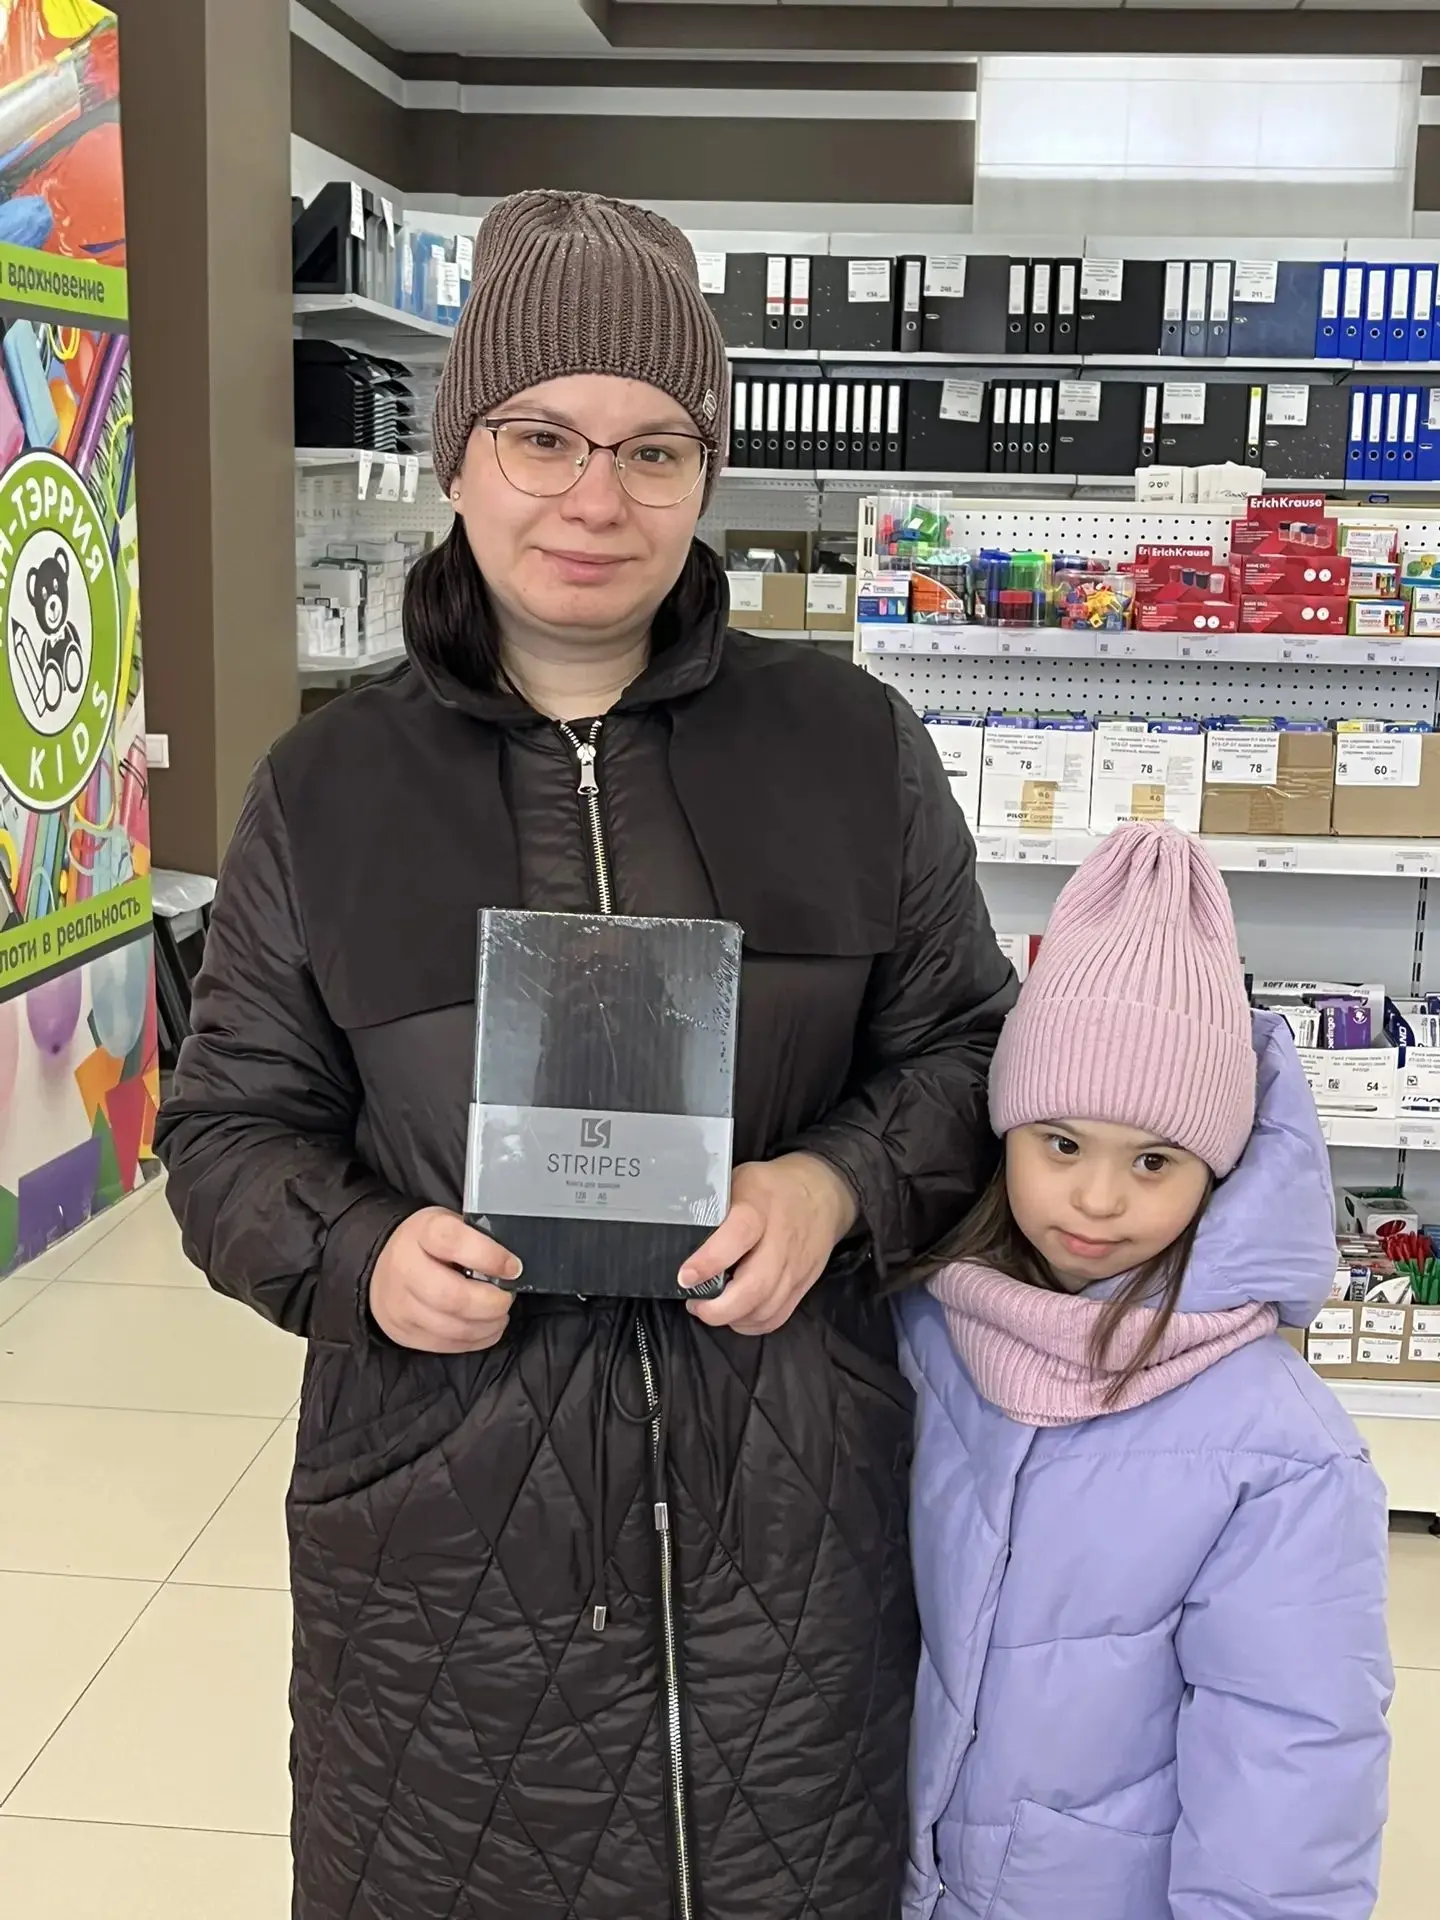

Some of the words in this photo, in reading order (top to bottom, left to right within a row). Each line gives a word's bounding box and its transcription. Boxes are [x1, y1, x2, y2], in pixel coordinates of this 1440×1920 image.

[8, 262, 105, 304] вдохновение
[1250, 497, 1323, 508] ErichKrause
[1152, 547, 1210, 557] ErichKrause
[29, 680, 108, 790] KIDS
[1020, 760, 1032, 770] 78
[1141, 764, 1153, 773] 78
[1249, 764, 1262, 773] 78
[1374, 765, 1387, 775] 60
[43, 932, 51, 955] в
[57, 896, 141, 955] реальность
[1366, 1082, 1379, 1091] 54
[581, 1118, 611, 1148] LS
[547, 1153, 641, 1177] STRIPES
